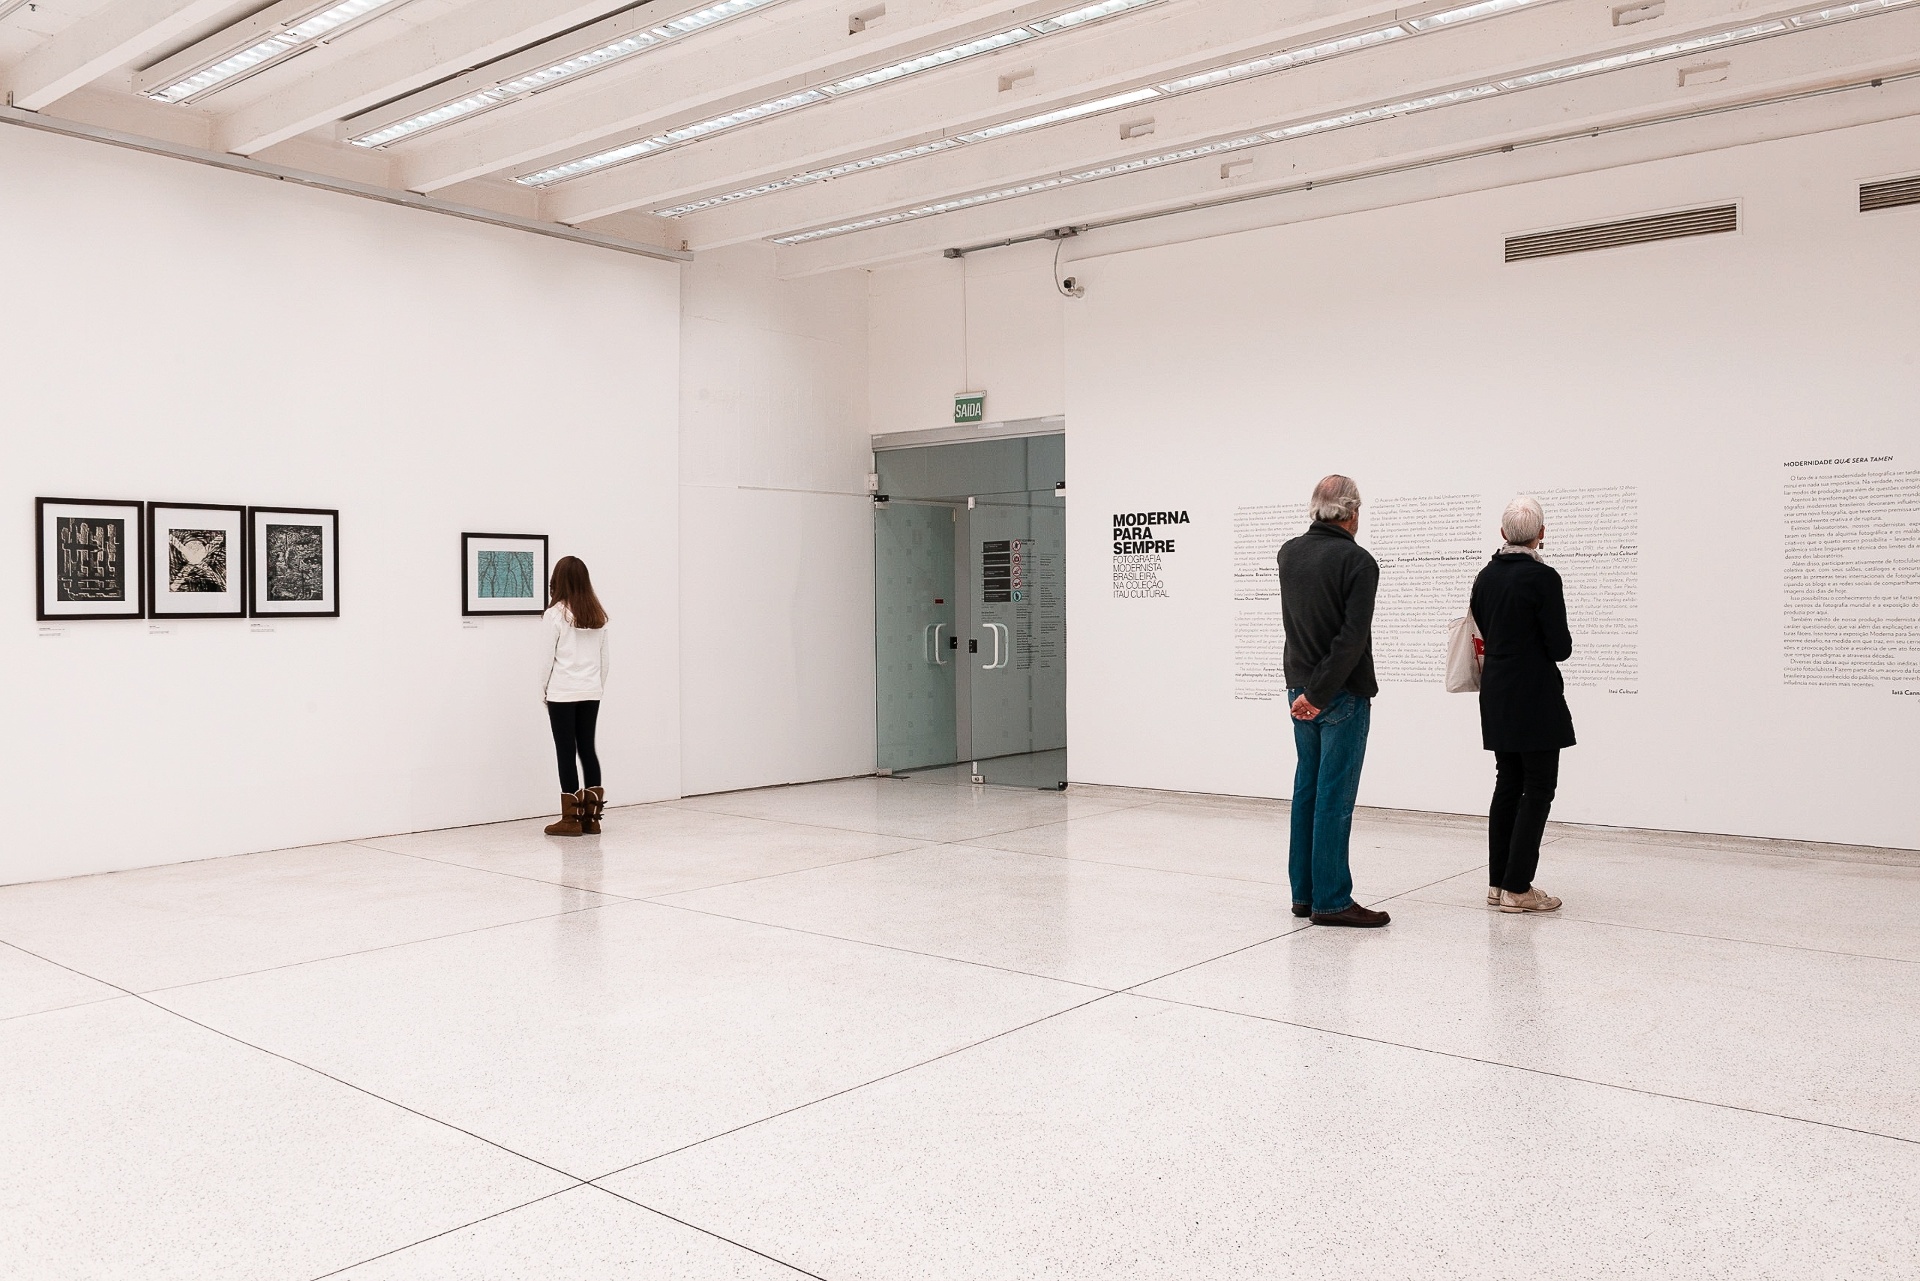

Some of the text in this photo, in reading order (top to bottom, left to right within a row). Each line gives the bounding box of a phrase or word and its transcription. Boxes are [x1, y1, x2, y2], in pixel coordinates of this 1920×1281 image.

[956, 403, 981, 418] SAÍDA
[1783, 459, 1832, 467] MODERNIDADE
[1113, 511, 1190, 527] MODERNA
[1113, 527, 1153, 540] PARA
[1113, 540, 1175, 554] SEMPRE
[1113, 554, 1161, 563] FOTOGRAFIA
[1575, 551, 1603, 559] Photography
[1113, 563, 1162, 572] MODERNISTA
[1113, 572, 1157, 580] BRASILEIRA
[1113, 580, 1164, 590] NA COLEÇÃO
[1113, 589, 1170, 598] ITAÚ CULTURAL
